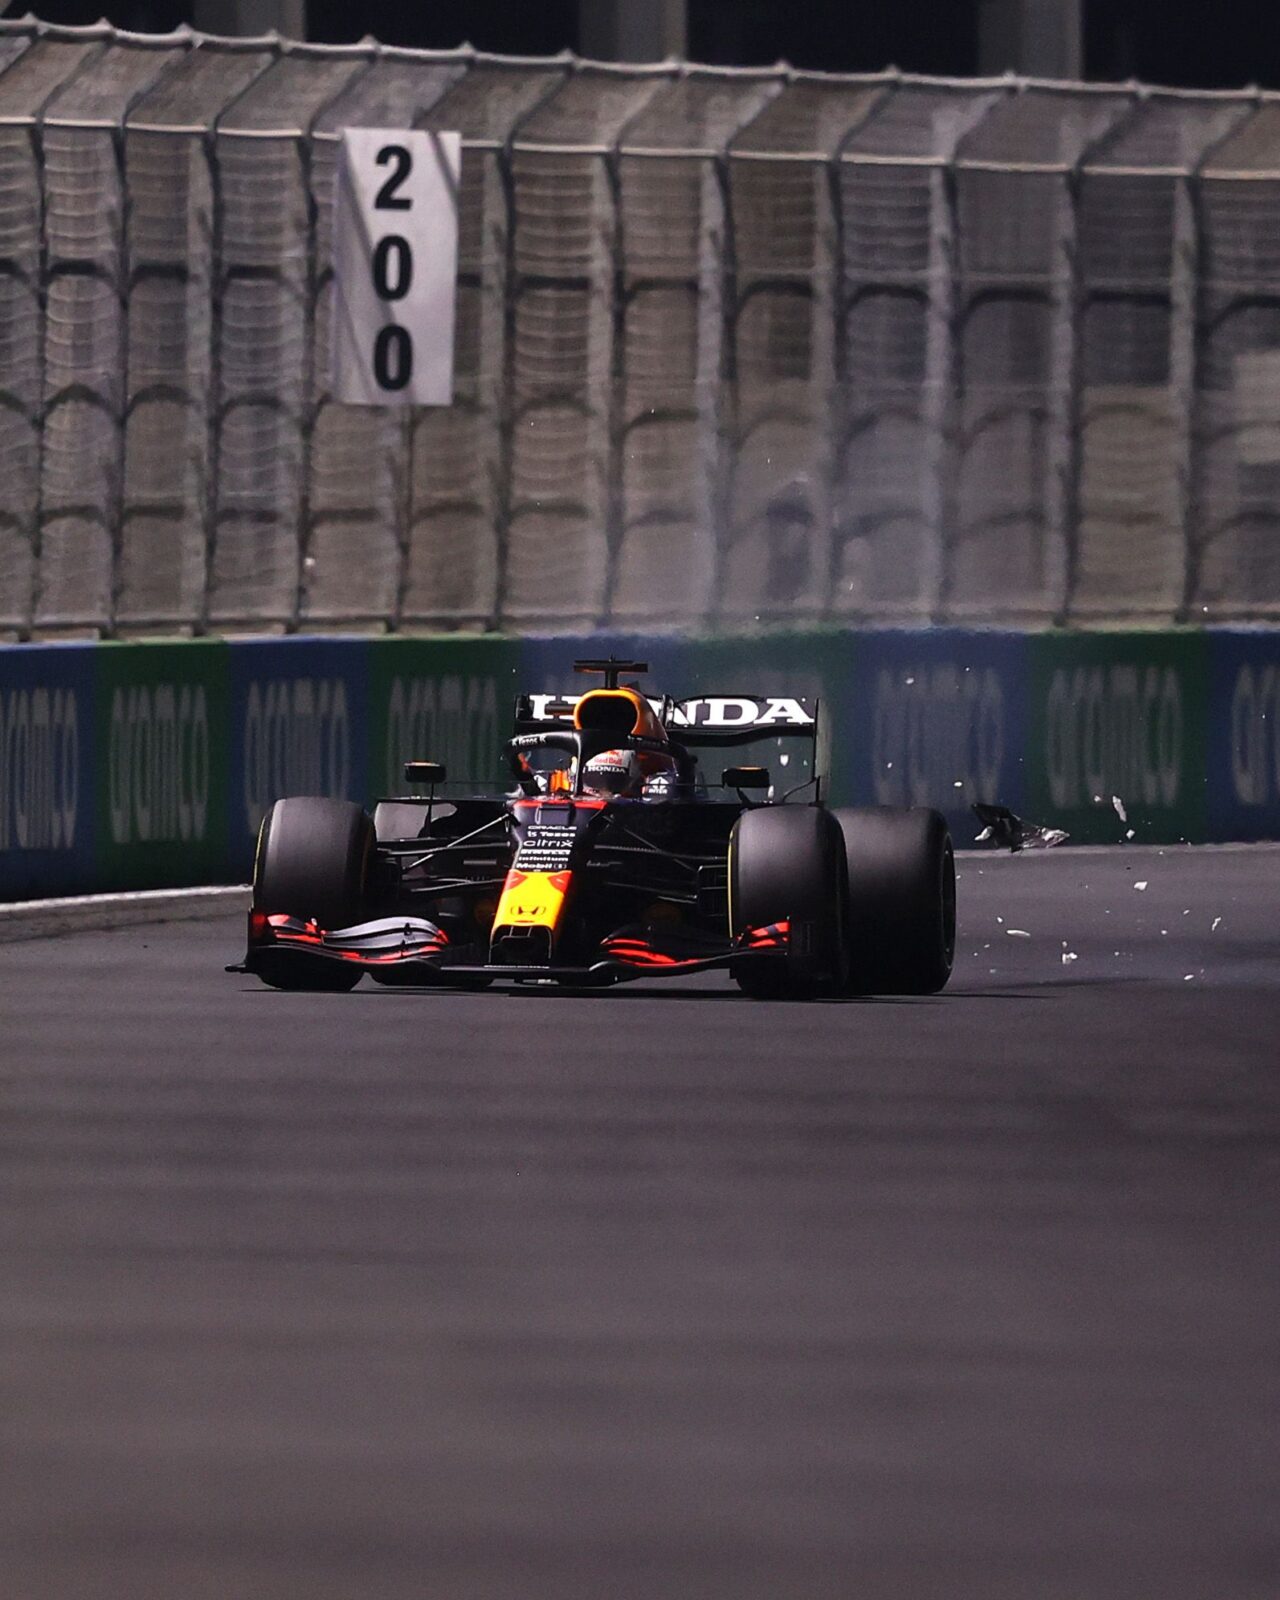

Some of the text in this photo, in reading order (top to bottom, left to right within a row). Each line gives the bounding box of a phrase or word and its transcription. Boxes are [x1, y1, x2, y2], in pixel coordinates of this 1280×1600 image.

[373, 145, 413, 391] 200
[529, 694, 815, 726] HNDA
[588, 765, 626, 774] HONDA
